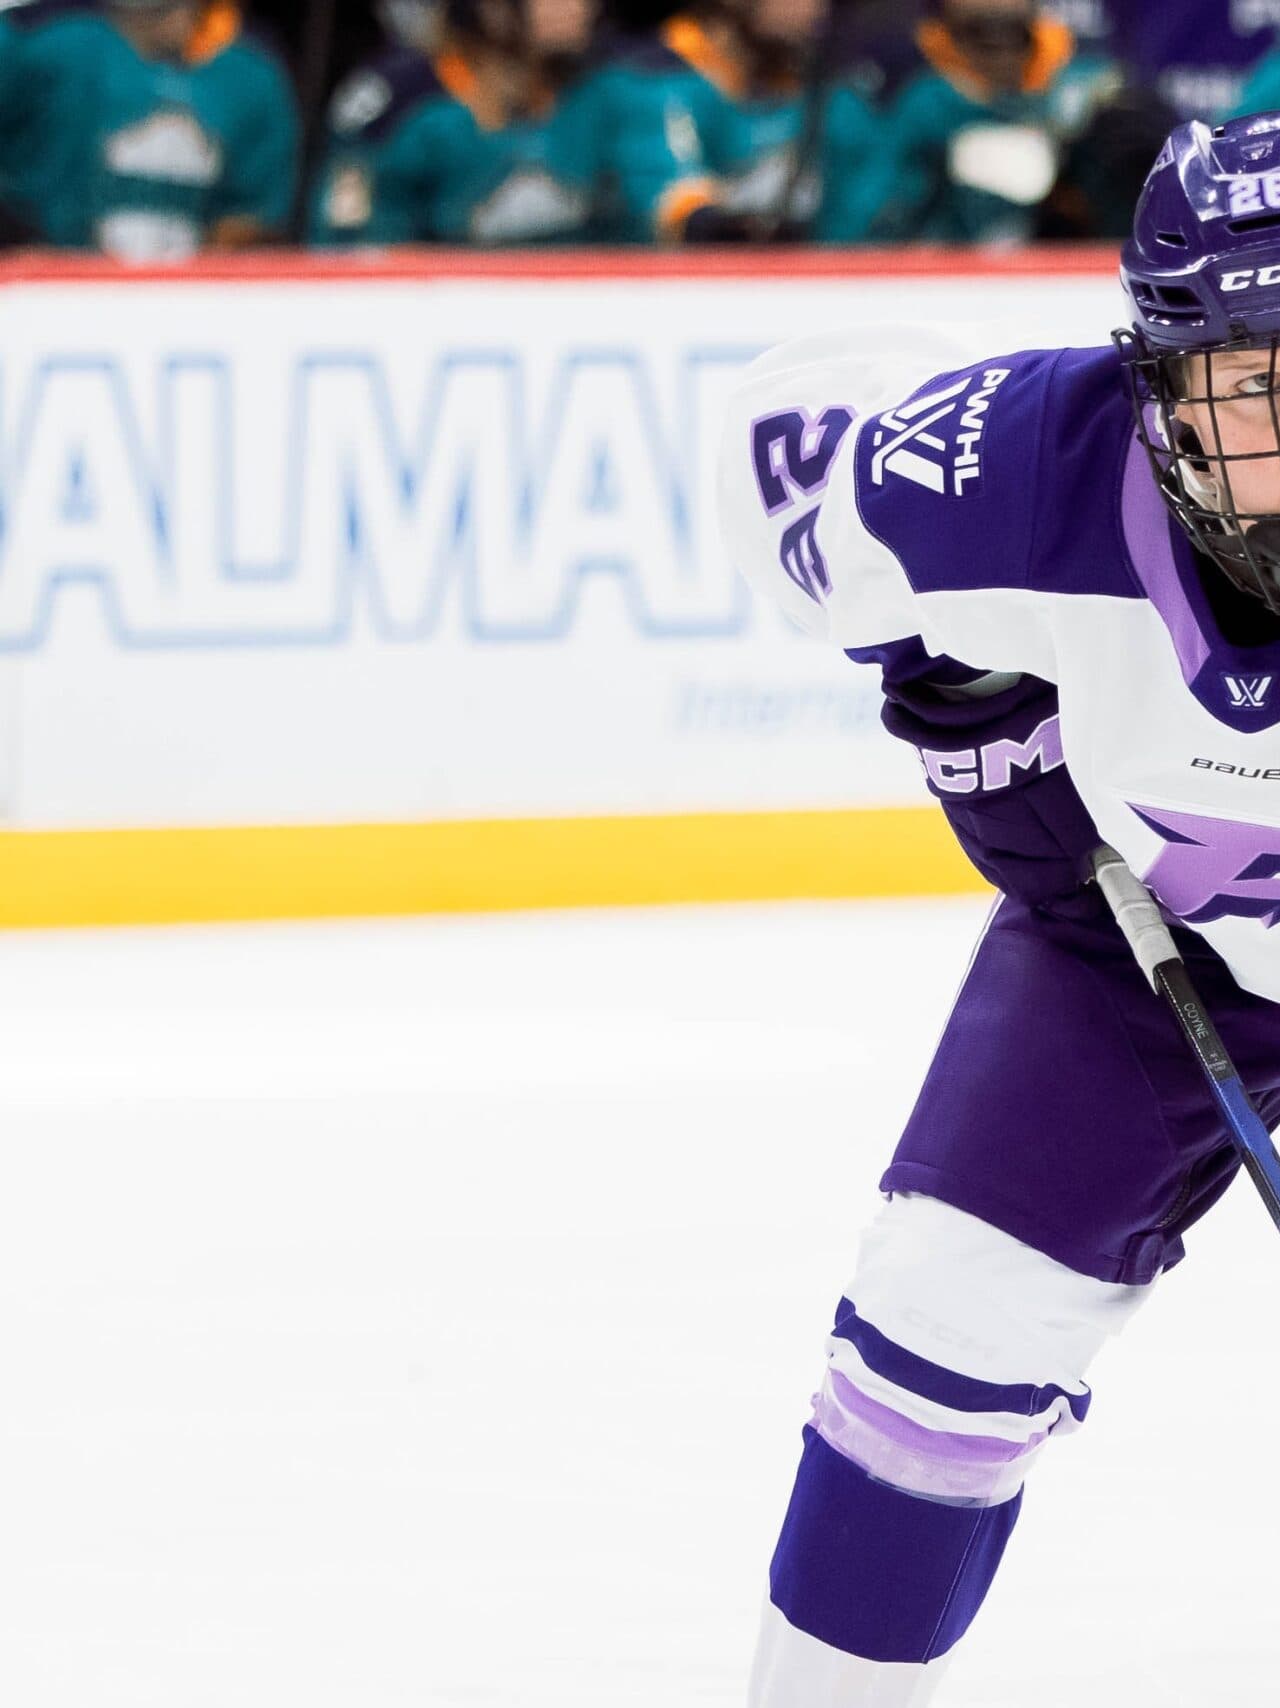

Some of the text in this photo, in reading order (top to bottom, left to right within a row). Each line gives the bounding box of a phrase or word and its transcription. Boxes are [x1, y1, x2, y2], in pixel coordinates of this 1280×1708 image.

[953, 368, 1012, 497] PWHL
[0, 345, 808, 656] ALMA
[913, 713, 1065, 794] CM
[1183, 1002, 1209, 1039] COYNE
